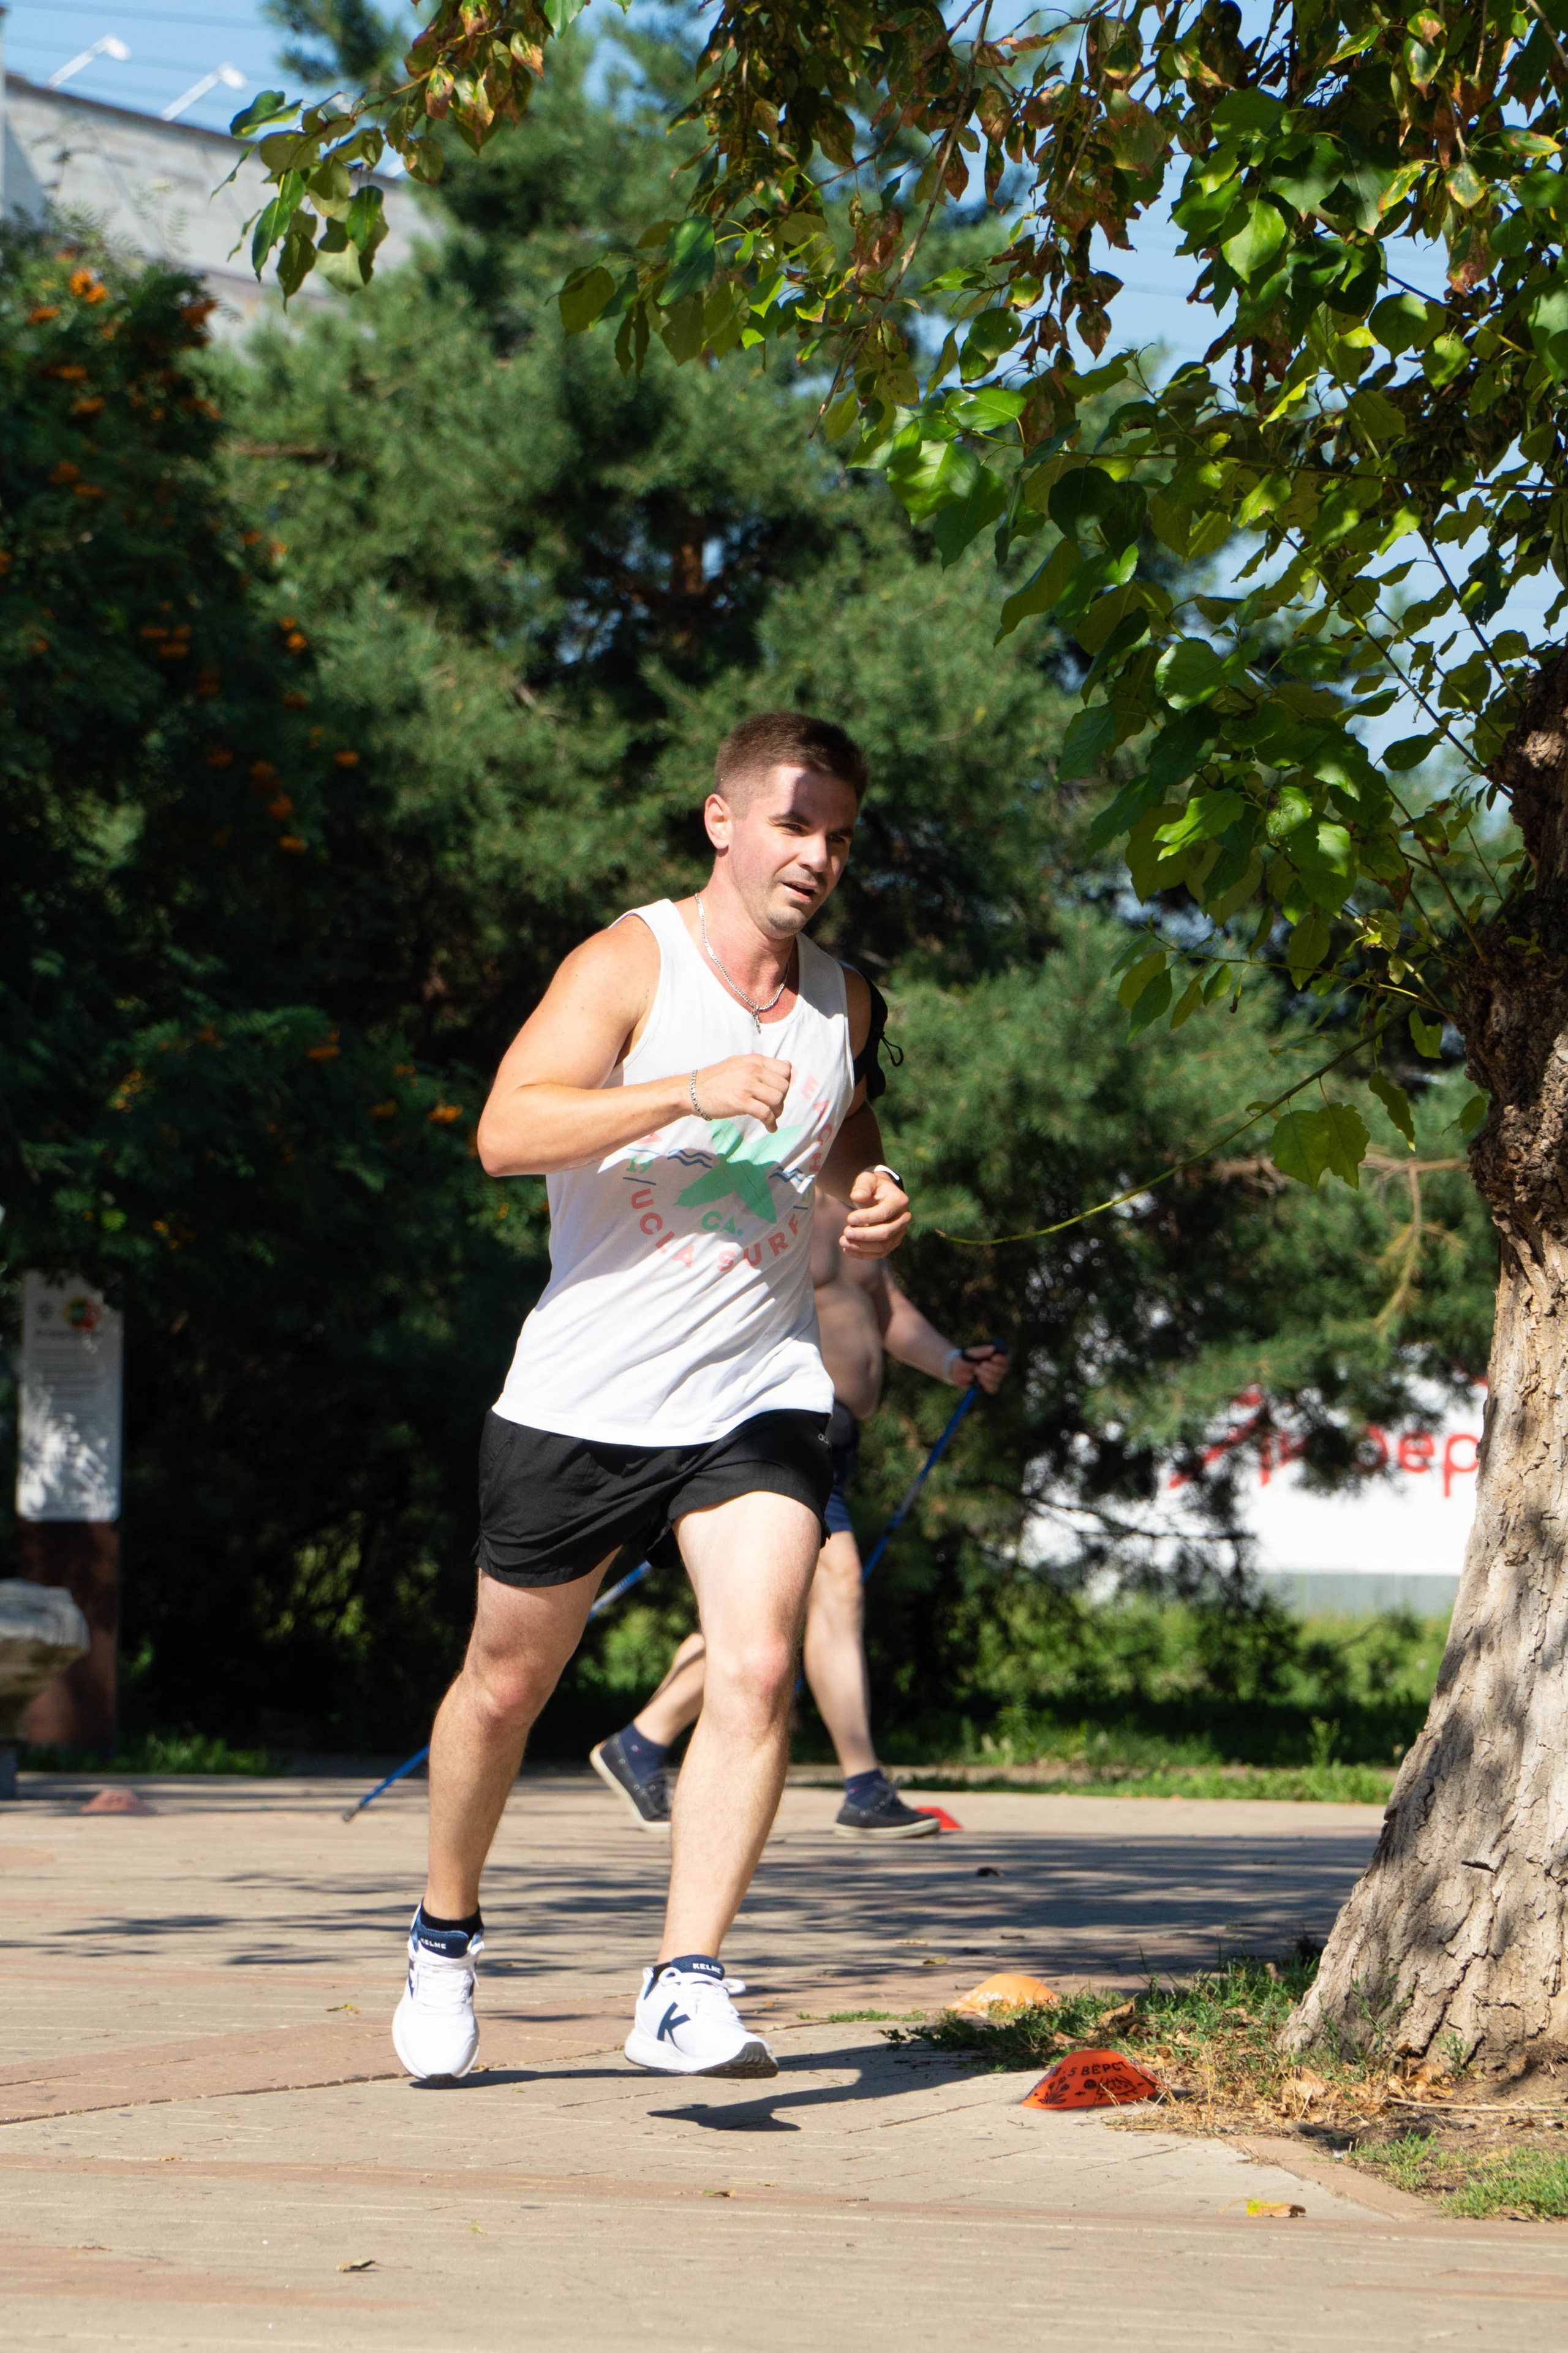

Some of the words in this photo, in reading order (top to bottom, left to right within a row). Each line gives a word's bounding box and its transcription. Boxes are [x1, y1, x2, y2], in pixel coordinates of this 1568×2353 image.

[701, 1210, 743, 1236] CA.
[717, 1213, 799, 1272] SURF
[420, 1937, 447, 1950] KELME
[692, 1962, 722, 1974] KELME
[1080, 2061, 1128, 2076] ВЁРСТ
